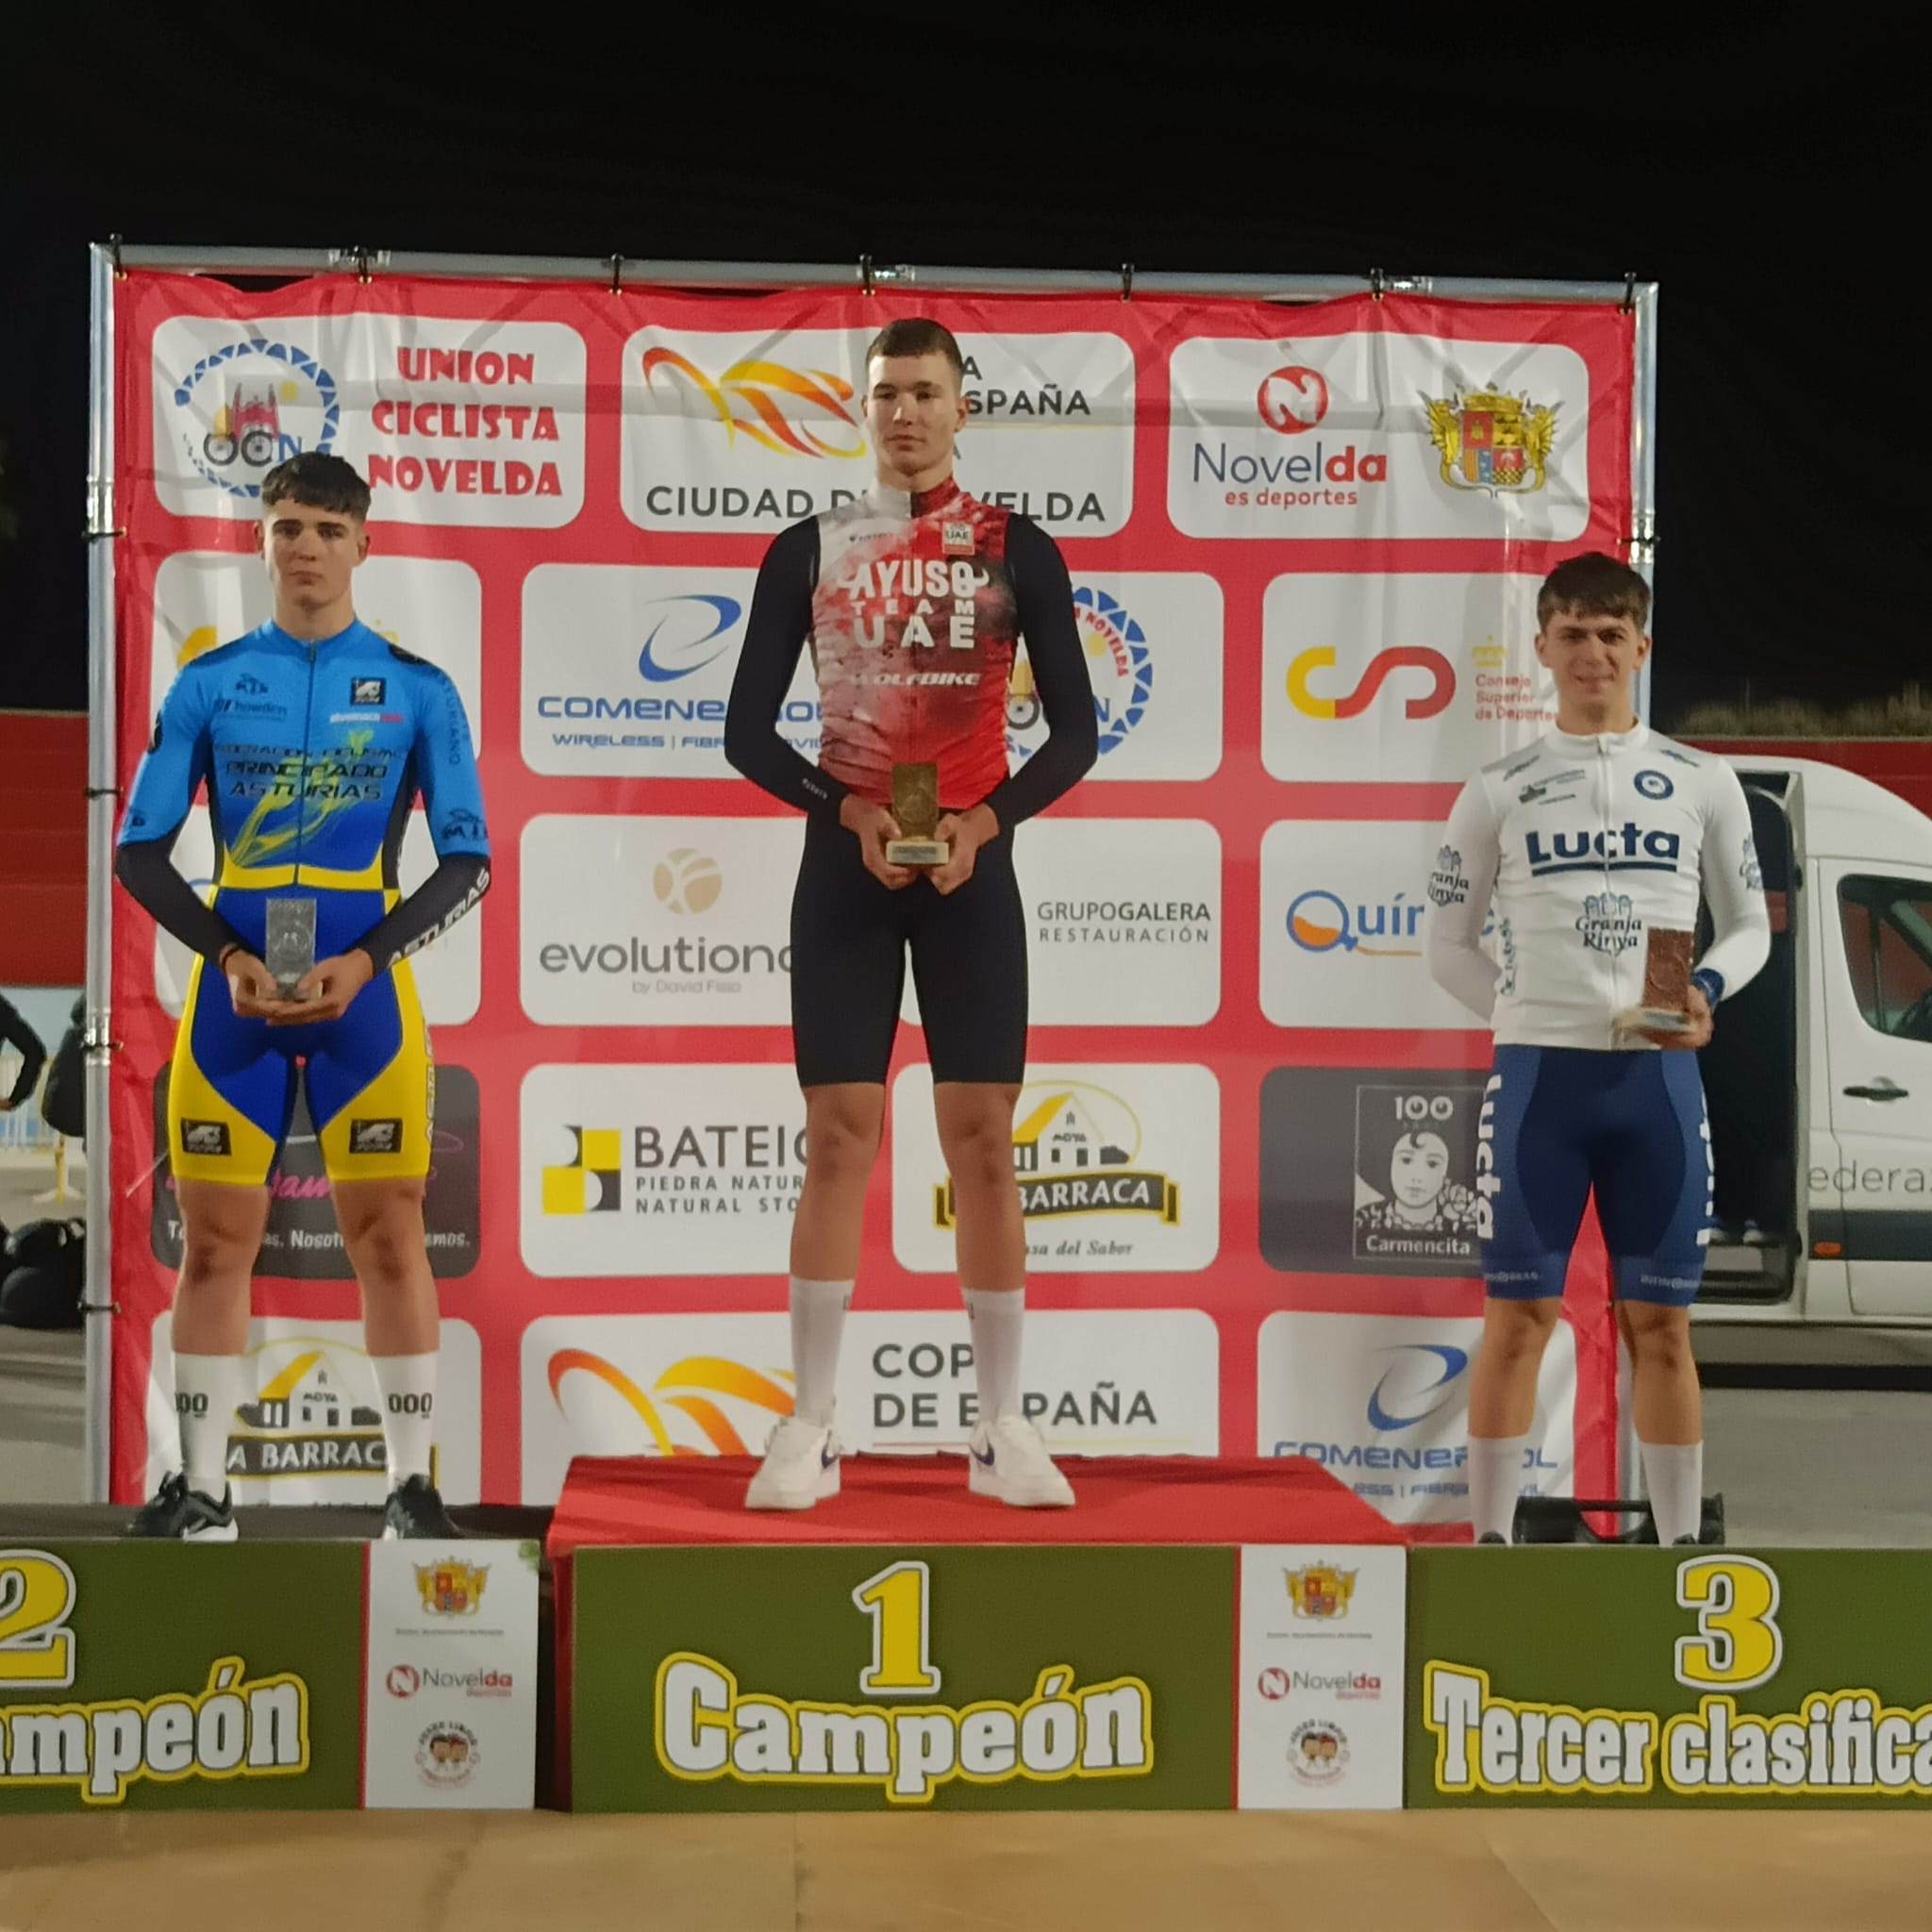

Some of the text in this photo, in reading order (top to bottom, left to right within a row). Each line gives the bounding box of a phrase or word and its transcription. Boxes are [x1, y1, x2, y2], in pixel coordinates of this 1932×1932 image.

[397, 347, 534, 385] UNION
[963, 383, 1091, 415] SPAÑA
[372, 401, 559, 441] CICLISTA
[368, 457, 562, 496] NOVELDA
[1193, 442, 1387, 484] Novelda
[646, 486, 814, 518] CIUDAD
[1225, 488, 1358, 509] es deportes
[946, 530, 969, 540] UAE
[850, 558, 977, 598] AYUSO
[852, 598, 974, 616] TEAM
[853, 615, 974, 649] UAE
[857, 672, 980, 686] OLFBIKE
[229, 782, 381, 801] ASTURIAS
[1525, 823, 1680, 865] Lucta
[1432, 871, 1470, 891] ranja
[1037, 902, 1211, 922] GRUPOGALERA
[1575, 915, 1642, 935] Granja
[1040, 926, 1208, 943] RESTAURACIÓN
[1395, 1095, 1455, 1120] 100
[636, 1175, 804, 1191] PIEDRA NATUR
[1808, 1159, 1932, 1192] edera
[636, 1197, 799, 1213] NATURAL STO
[1366, 1234, 1470, 1256] Carmencita
[873, 1343, 974, 1378] COP
[874, 1382, 1158, 1427] DE EPAÑA
[261, 1440, 384, 1470] BARRAC
[0, 1549, 76, 1690] 2
[852, 1561, 941, 1695] 1
[1674, 1554, 1782, 1690] 3
[423, 1668, 513, 1689] Novelda
[1292, 1671, 1382, 1690] Novelda
[0, 1656, 309, 1805] mpeón
[655, 1651, 1153, 1804] Campeón
[1424, 1659, 1658, 1793] Tercer
